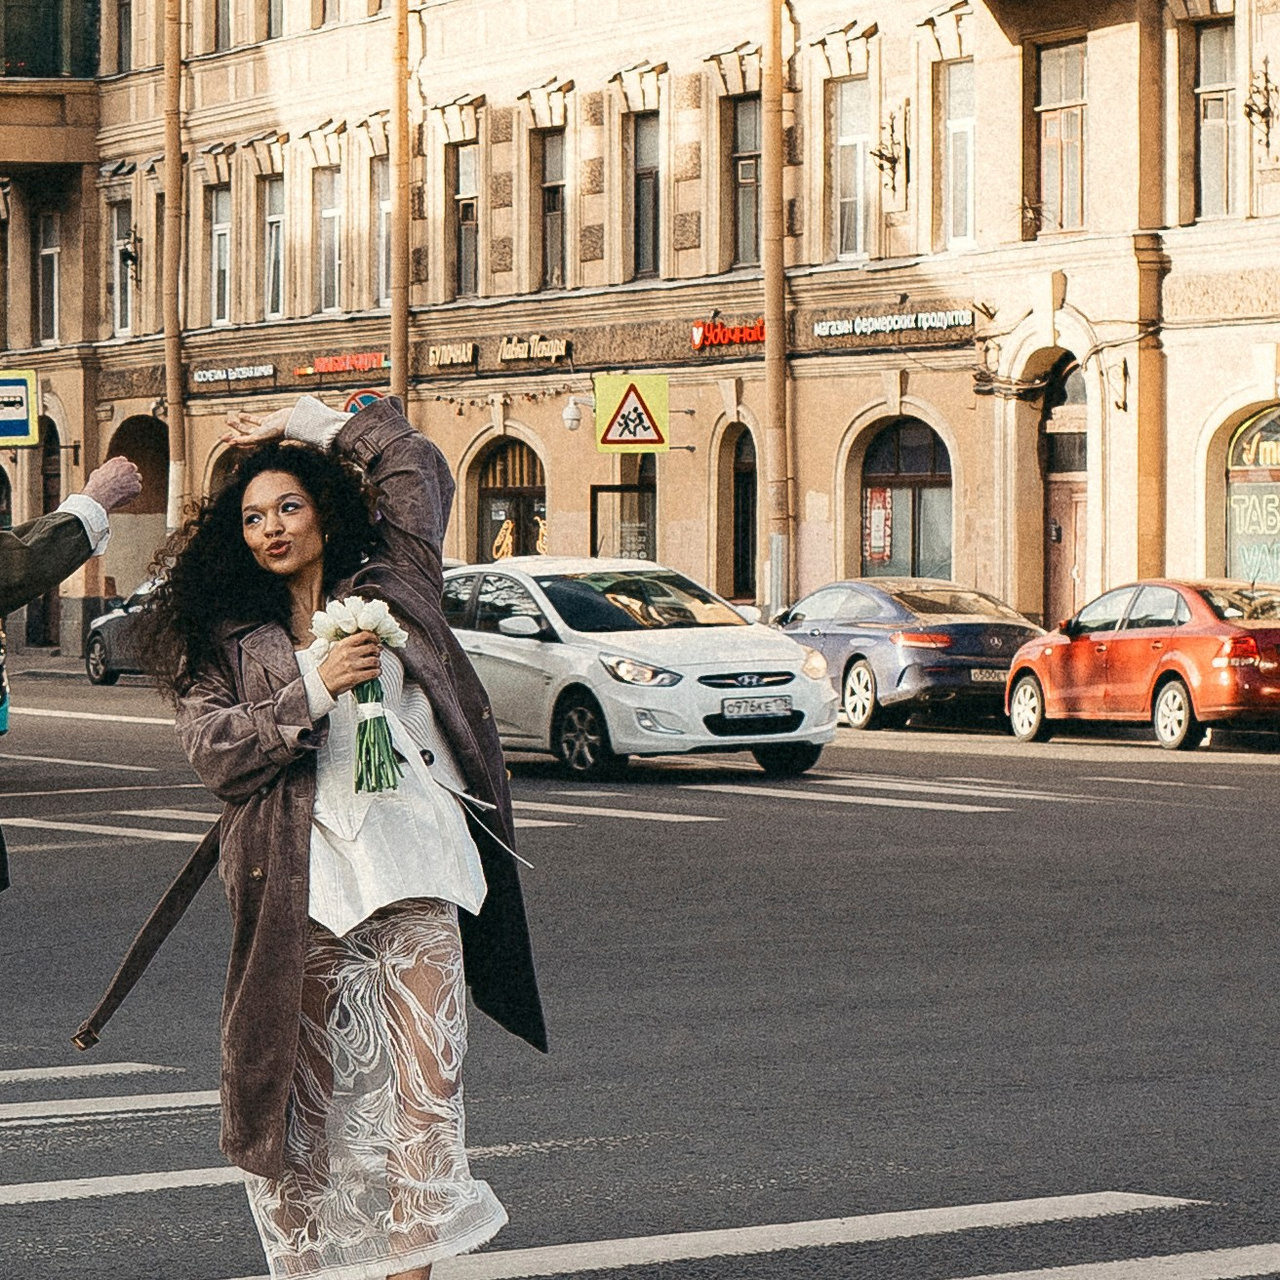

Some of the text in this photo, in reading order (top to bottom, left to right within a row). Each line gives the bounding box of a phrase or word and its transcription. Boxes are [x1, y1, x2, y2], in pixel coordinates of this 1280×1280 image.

[814, 310, 972, 336] магазин фермерских продуктов
[429, 342, 473, 366] БУЛОЧНАЯ
